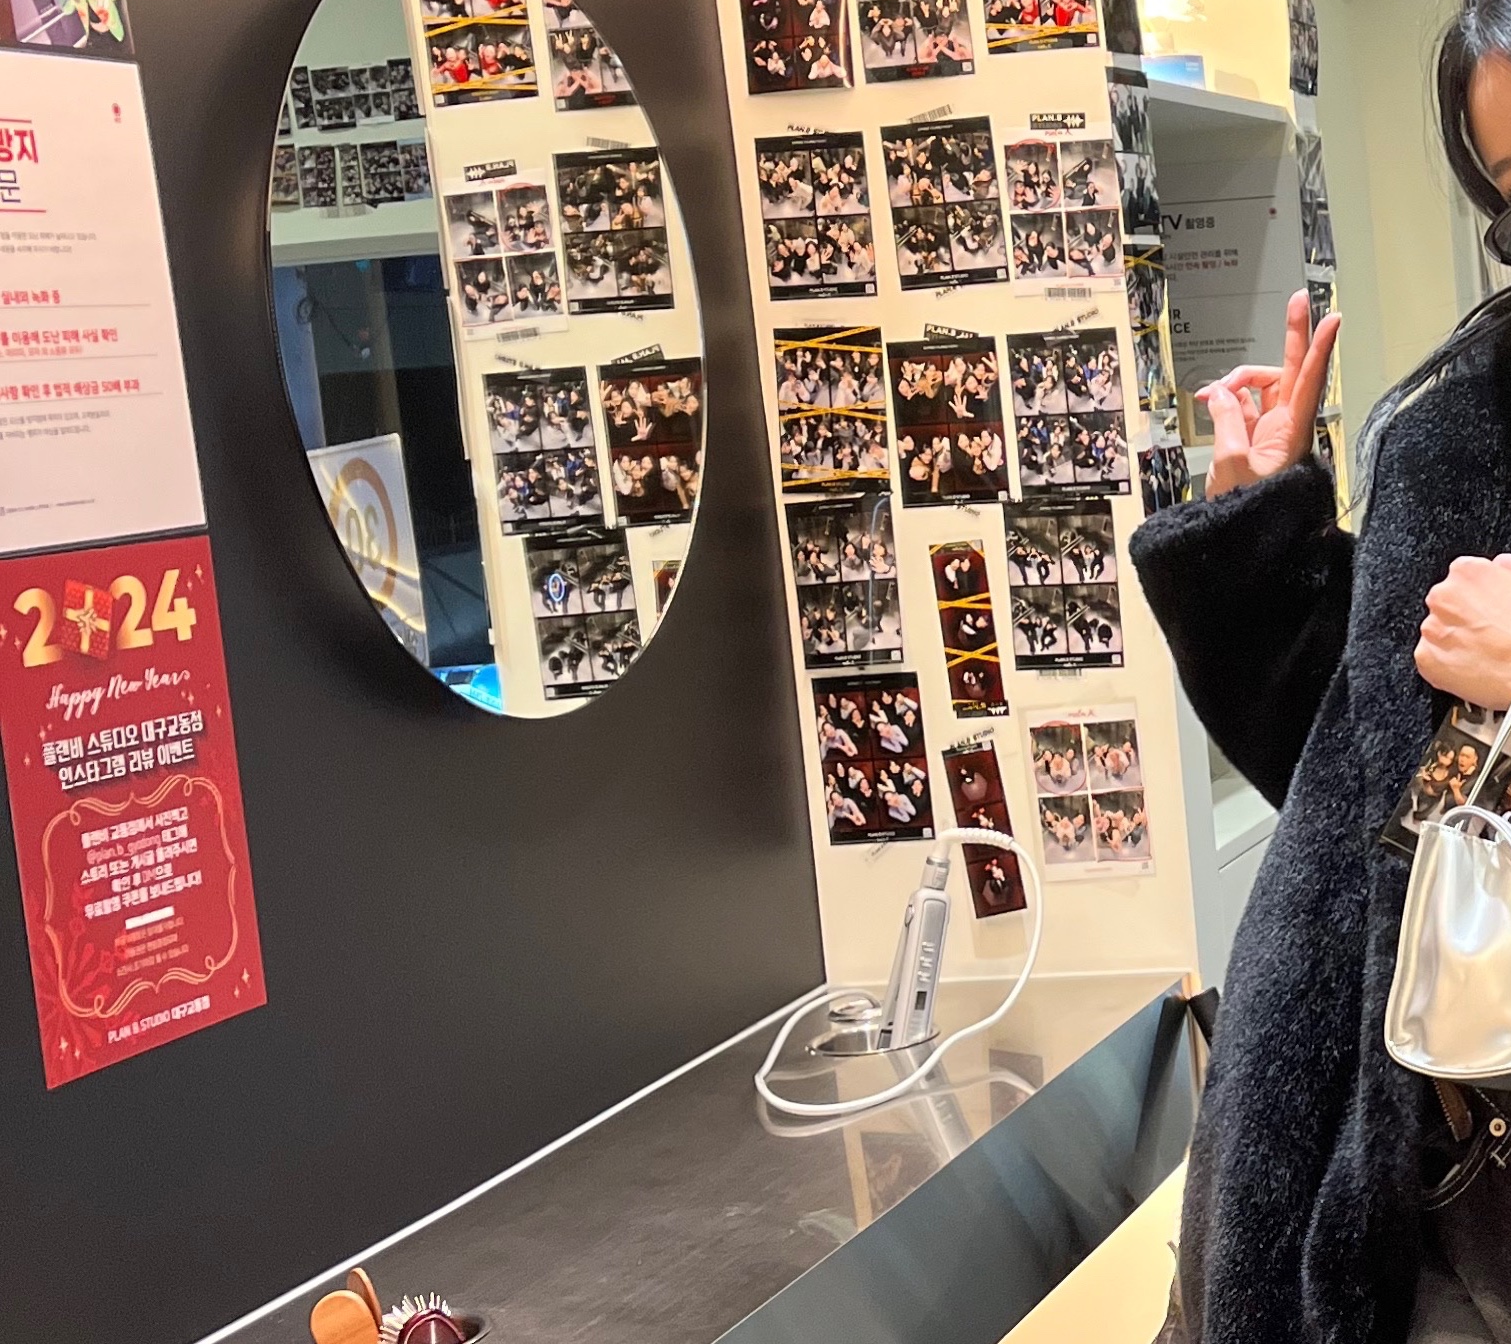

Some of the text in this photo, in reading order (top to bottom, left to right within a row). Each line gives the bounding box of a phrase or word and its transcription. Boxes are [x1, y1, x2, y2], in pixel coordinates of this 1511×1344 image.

[46, 684, 106, 721] Happy
[107, 675, 143, 699] New
[42, 710, 204, 766] 플랜비 스튜디오 대구교동점
[58, 738, 195, 790] 인스타그램 리뷰 이벤트
